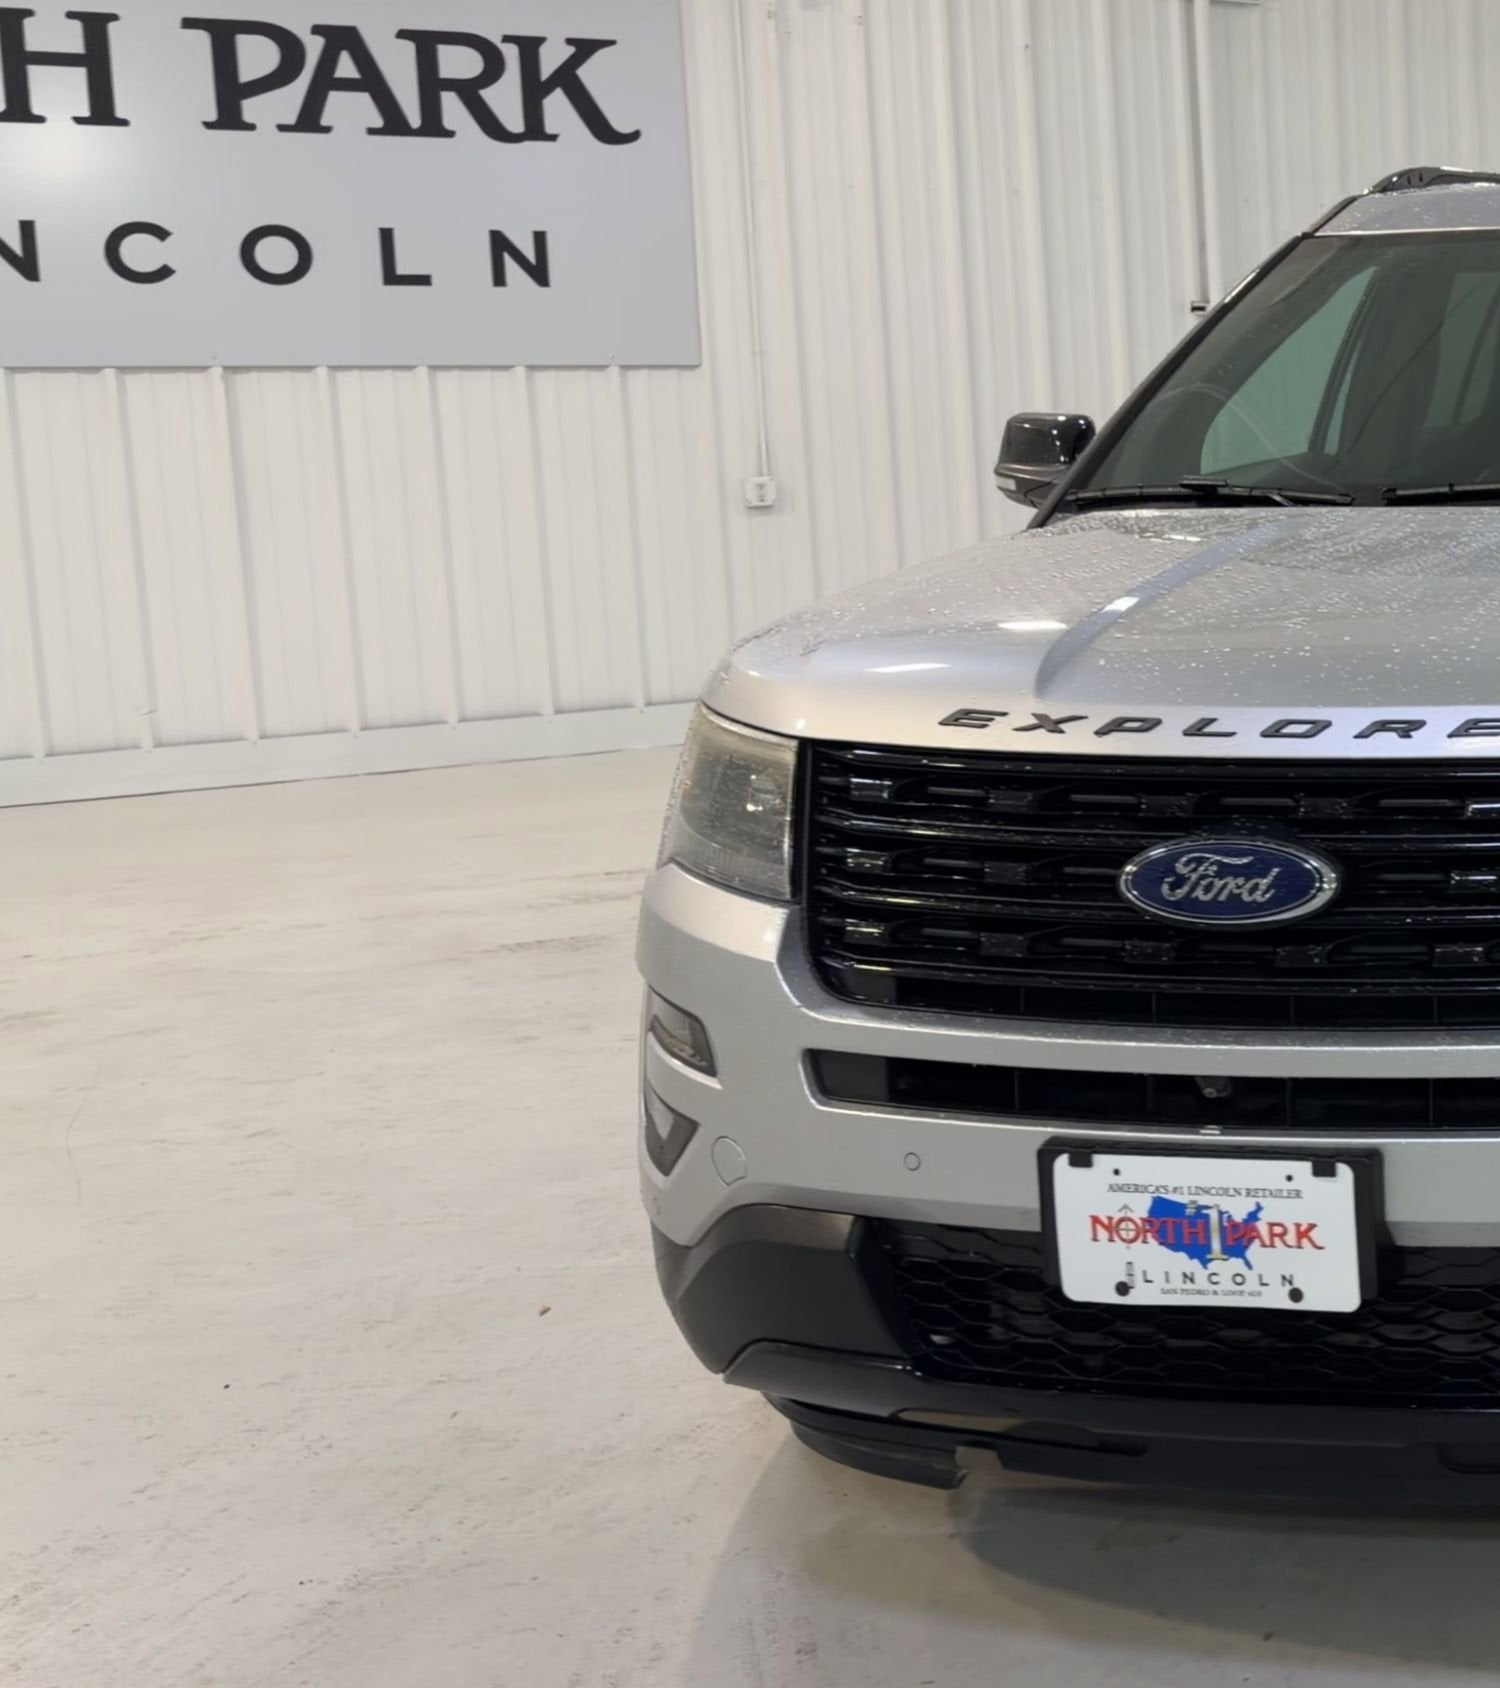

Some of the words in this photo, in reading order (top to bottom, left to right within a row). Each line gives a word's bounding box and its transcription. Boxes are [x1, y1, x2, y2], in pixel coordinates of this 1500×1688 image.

[180, 17, 642, 146] PARK
[1160, 852, 1281, 905] Ford
[1187, 1186, 1242, 1198] LINCOLN
[1245, 1188, 1303, 1199] RETAILER
[1089, 1215, 1207, 1246] NORTH
[1226, 1222, 1326, 1250] PARK
[1141, 1270, 1294, 1288] LINCOLN
